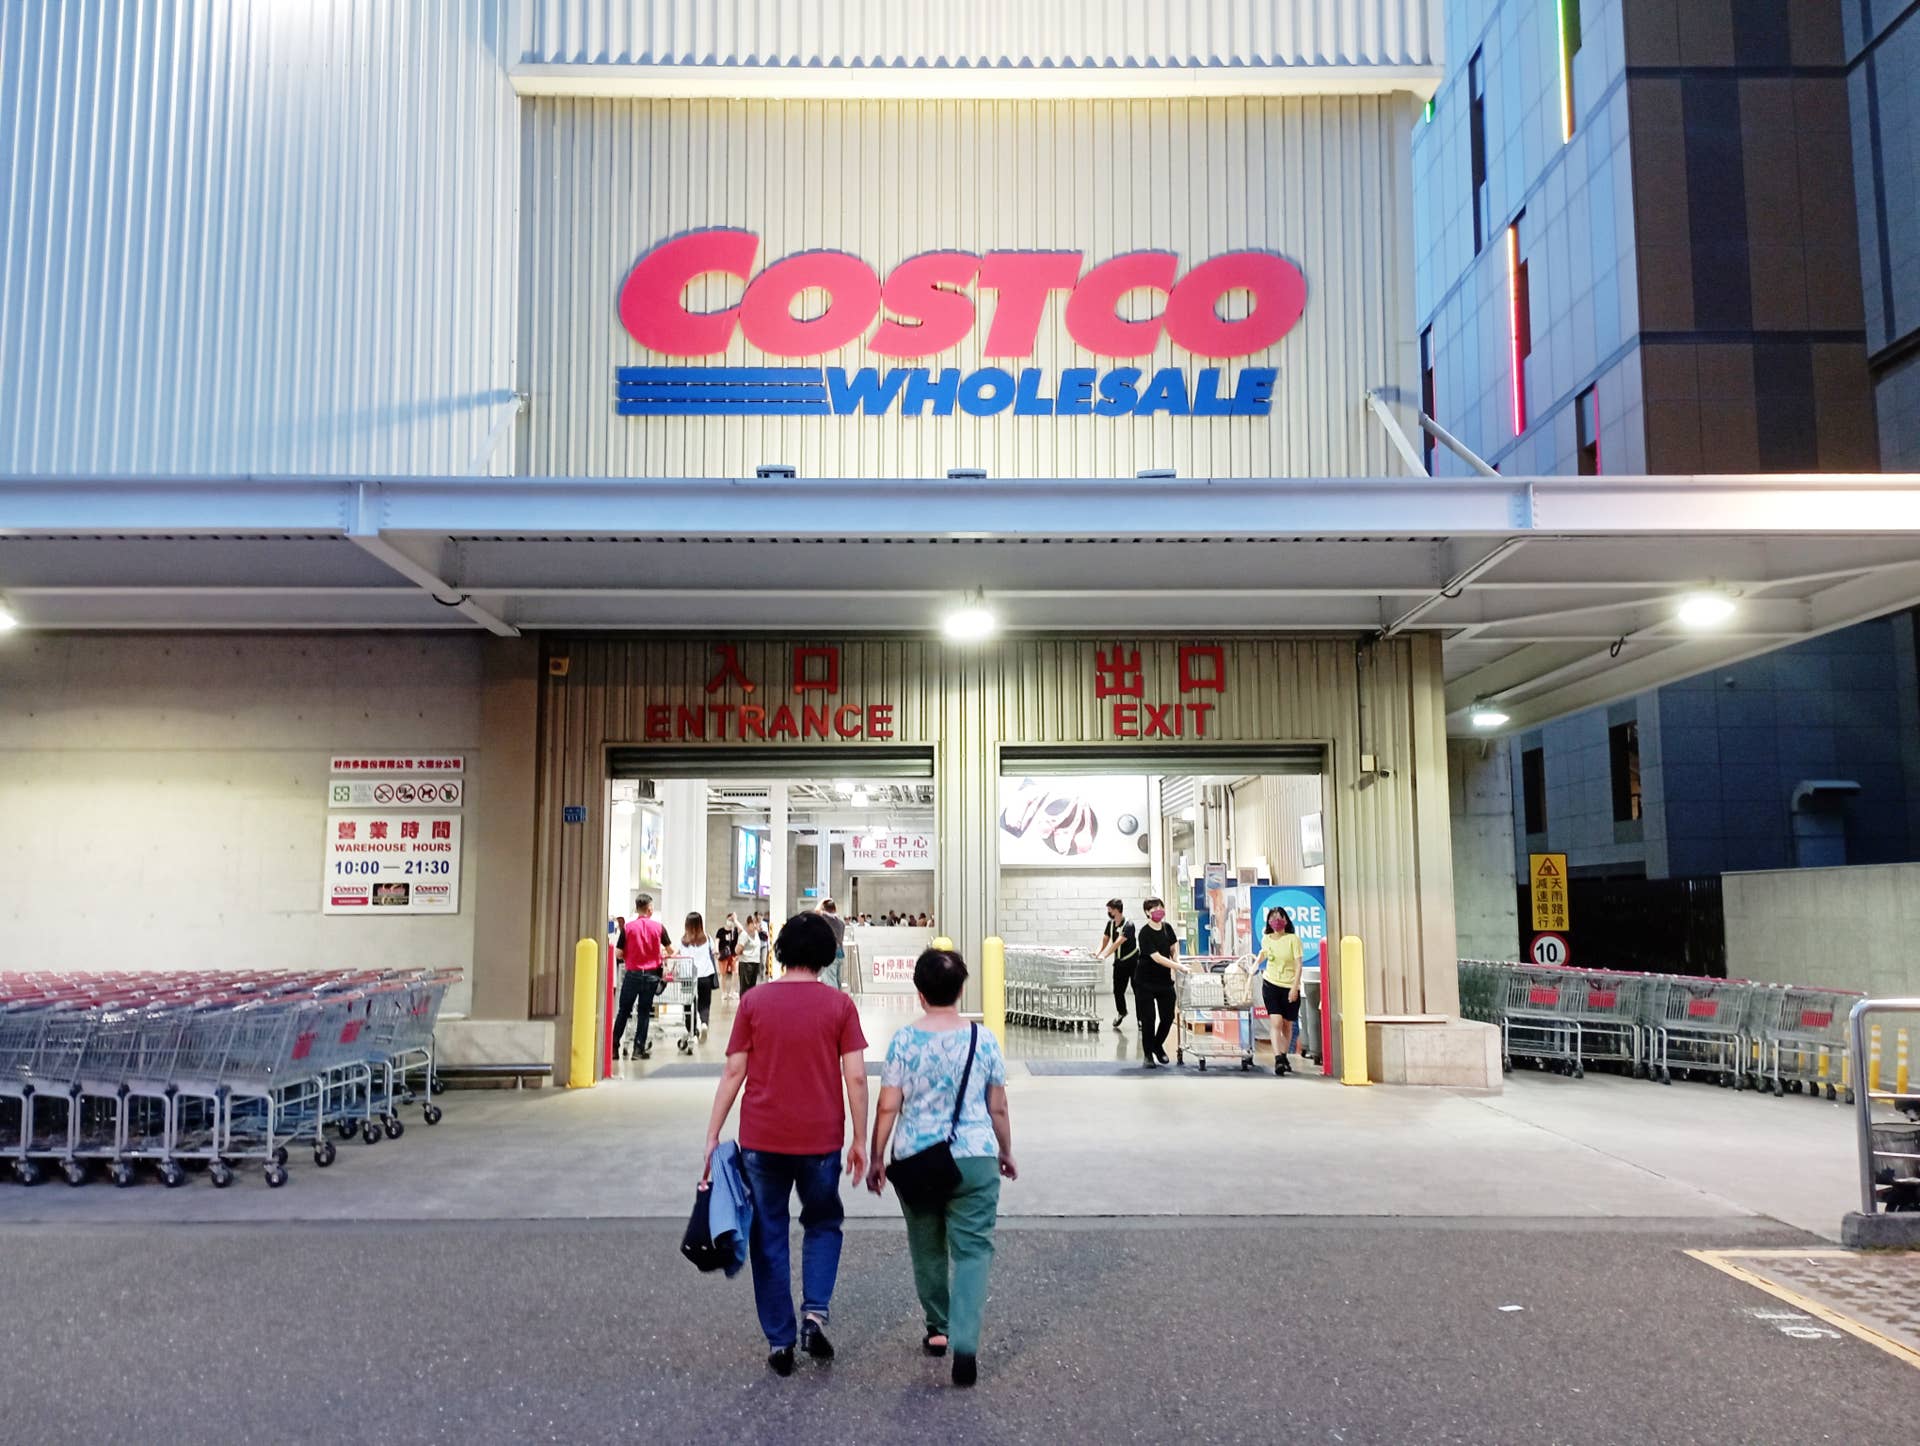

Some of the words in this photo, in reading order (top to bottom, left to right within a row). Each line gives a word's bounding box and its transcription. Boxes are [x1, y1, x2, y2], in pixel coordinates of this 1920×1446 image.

[617, 225, 1308, 358] COSTCO
[826, 366, 1278, 416] WHOLESALE
[705, 645, 839, 695] 入口
[1095, 645, 1226, 699] 出口
[645, 704, 894, 738] ENTRANCE
[1113, 703, 1215, 737] EXIT
[338, 821, 451, 839] 營業時間
[335, 843, 407, 853] WAREHOUSE
[412, 843, 452, 853] HOURS
[853, 850, 877, 858] TIRE
[883, 850, 928, 858] CENTER
[335, 860, 380, 875] 10:00
[404, 860, 450, 875] 21:30
[1536, 878, 1549, 928] 減速慢行
[1551, 878, 1564, 928] 天雨路滑
[873, 962, 885, 977] B1
[1536, 943, 1558, 962] 10
